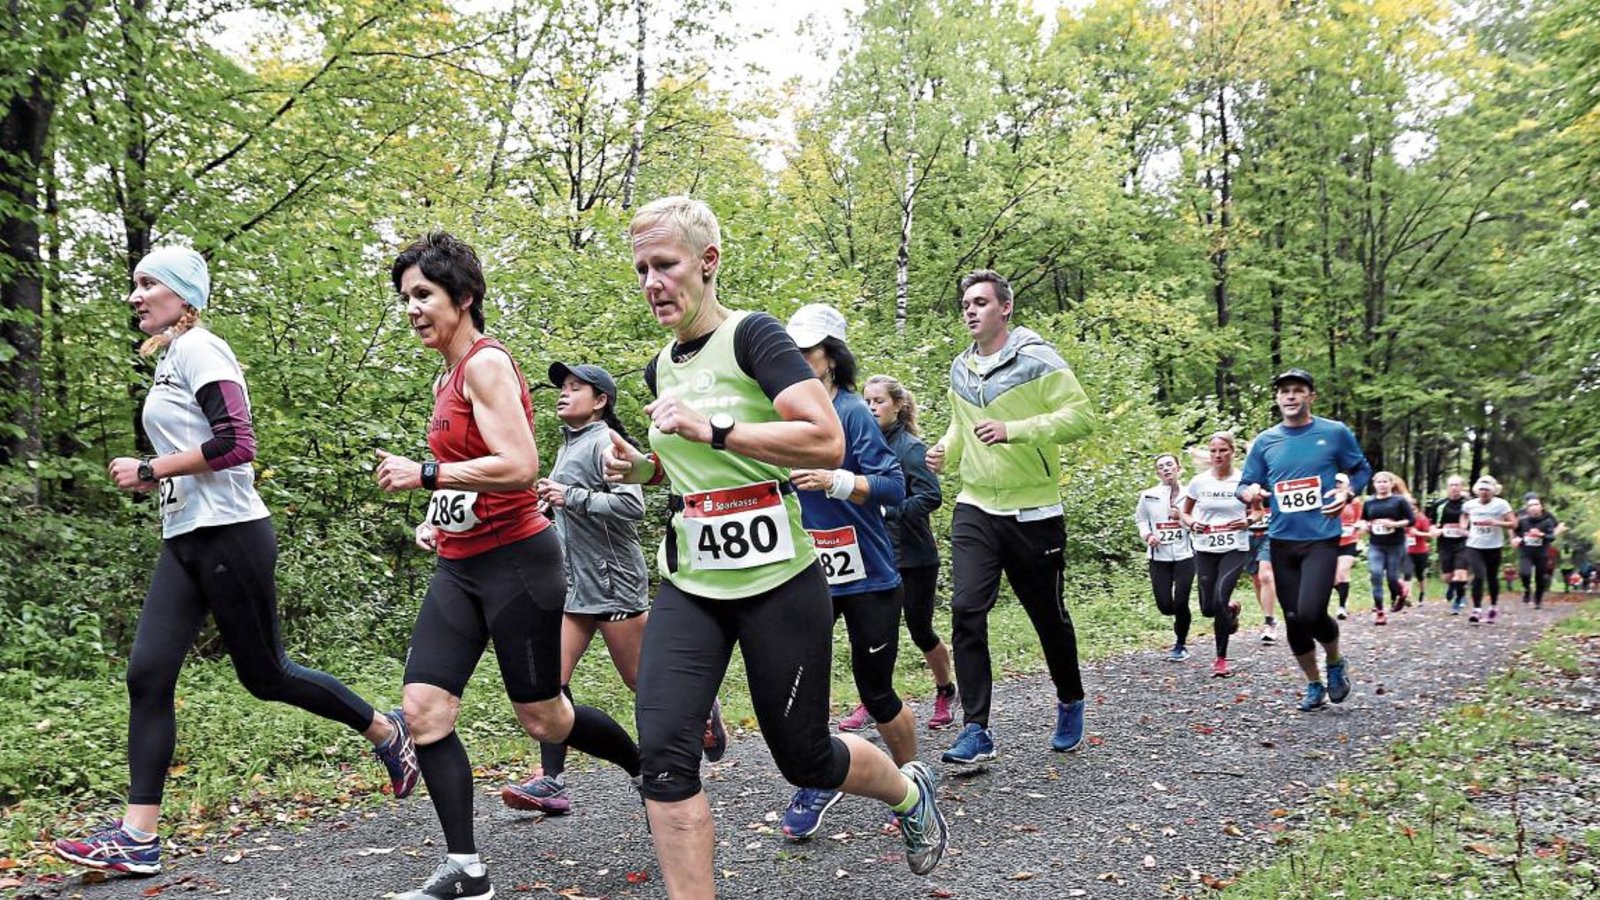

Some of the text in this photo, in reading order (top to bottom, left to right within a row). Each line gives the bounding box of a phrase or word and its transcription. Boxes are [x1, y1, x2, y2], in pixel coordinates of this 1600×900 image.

[715, 496, 758, 512] Sparkasse
[1282, 490, 1317, 508] 486
[431, 494, 466, 526] 286
[698, 515, 778, 560] 480
[1160, 530, 1183, 541] 224
[1209, 534, 1235, 547] 285
